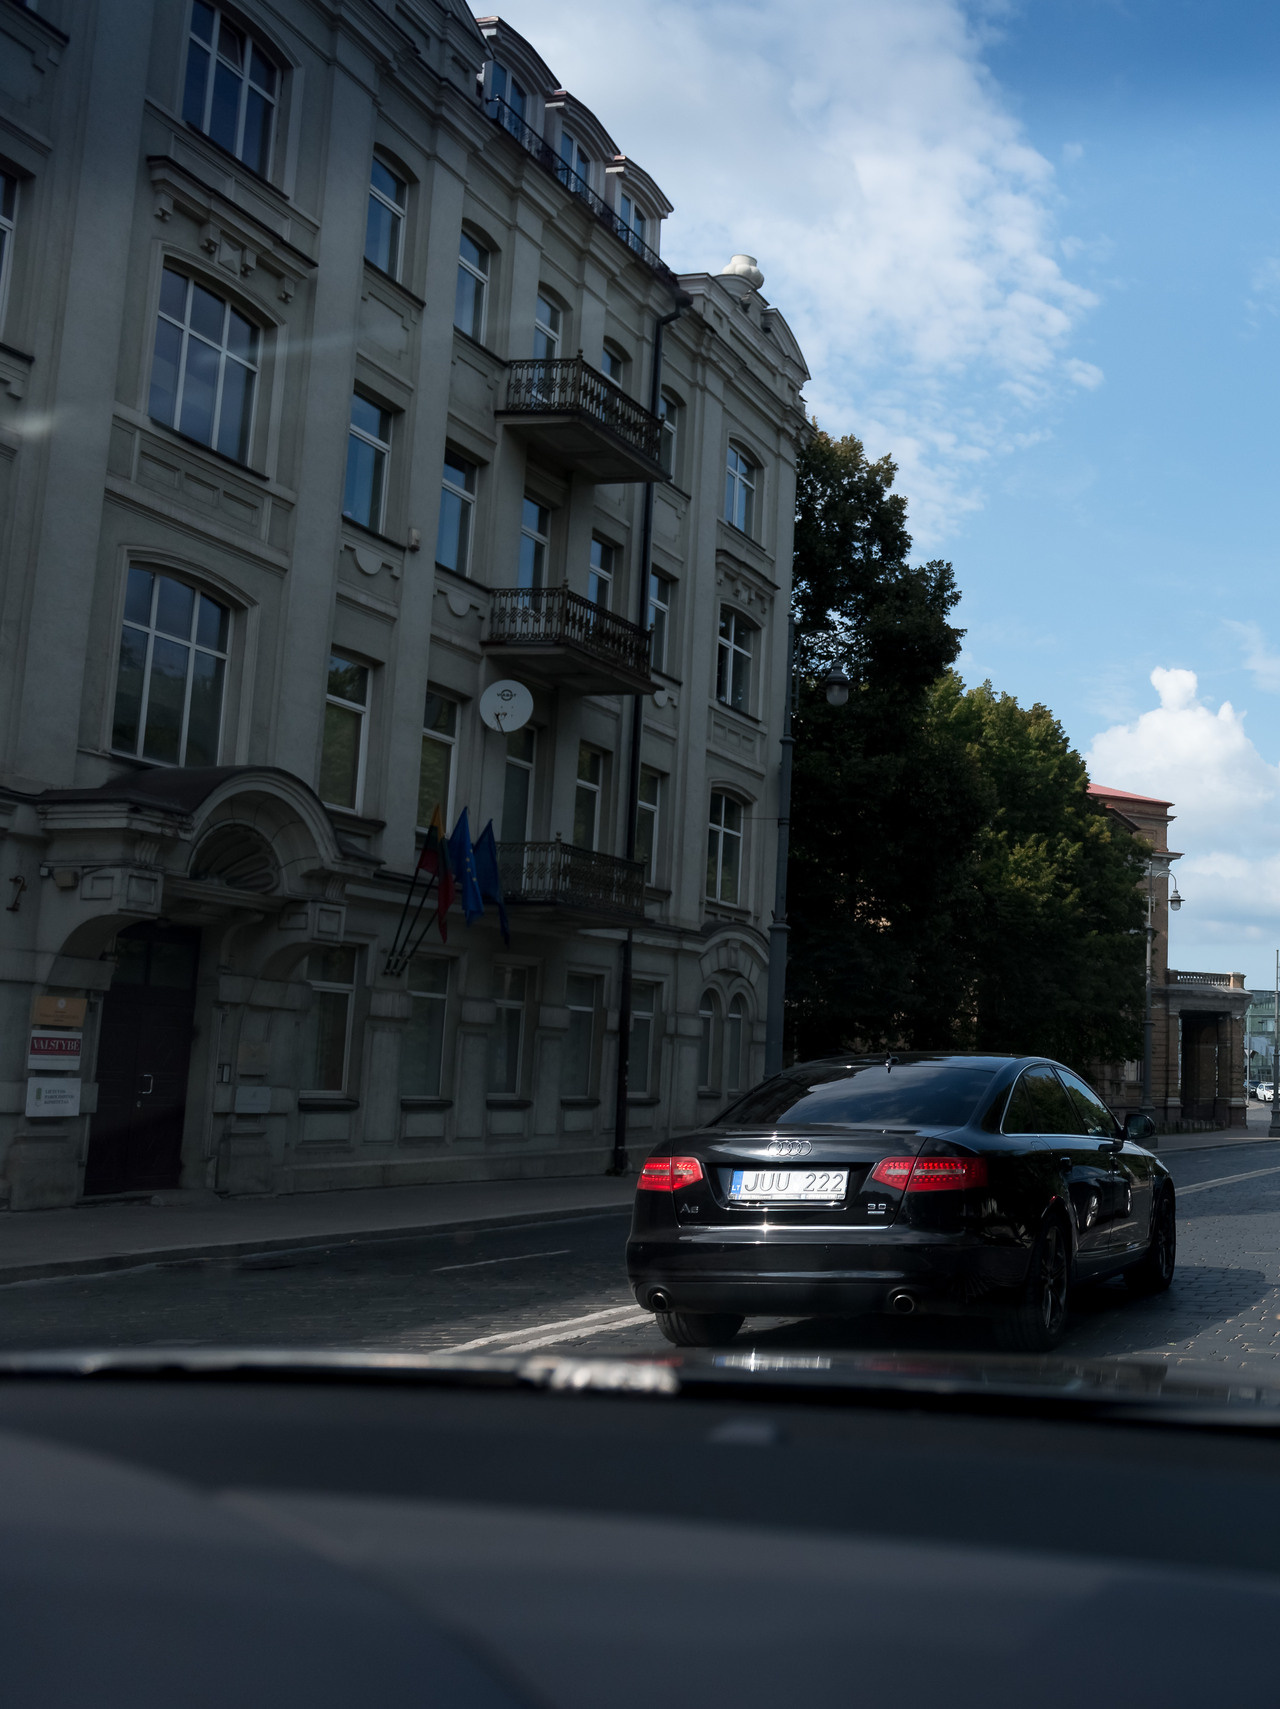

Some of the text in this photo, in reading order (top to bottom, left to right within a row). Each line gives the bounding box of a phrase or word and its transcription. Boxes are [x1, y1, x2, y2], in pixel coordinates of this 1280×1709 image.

[33, 1039, 80, 1051] VALSTYBĖ
[744, 1172, 844, 1192] JUU 222
